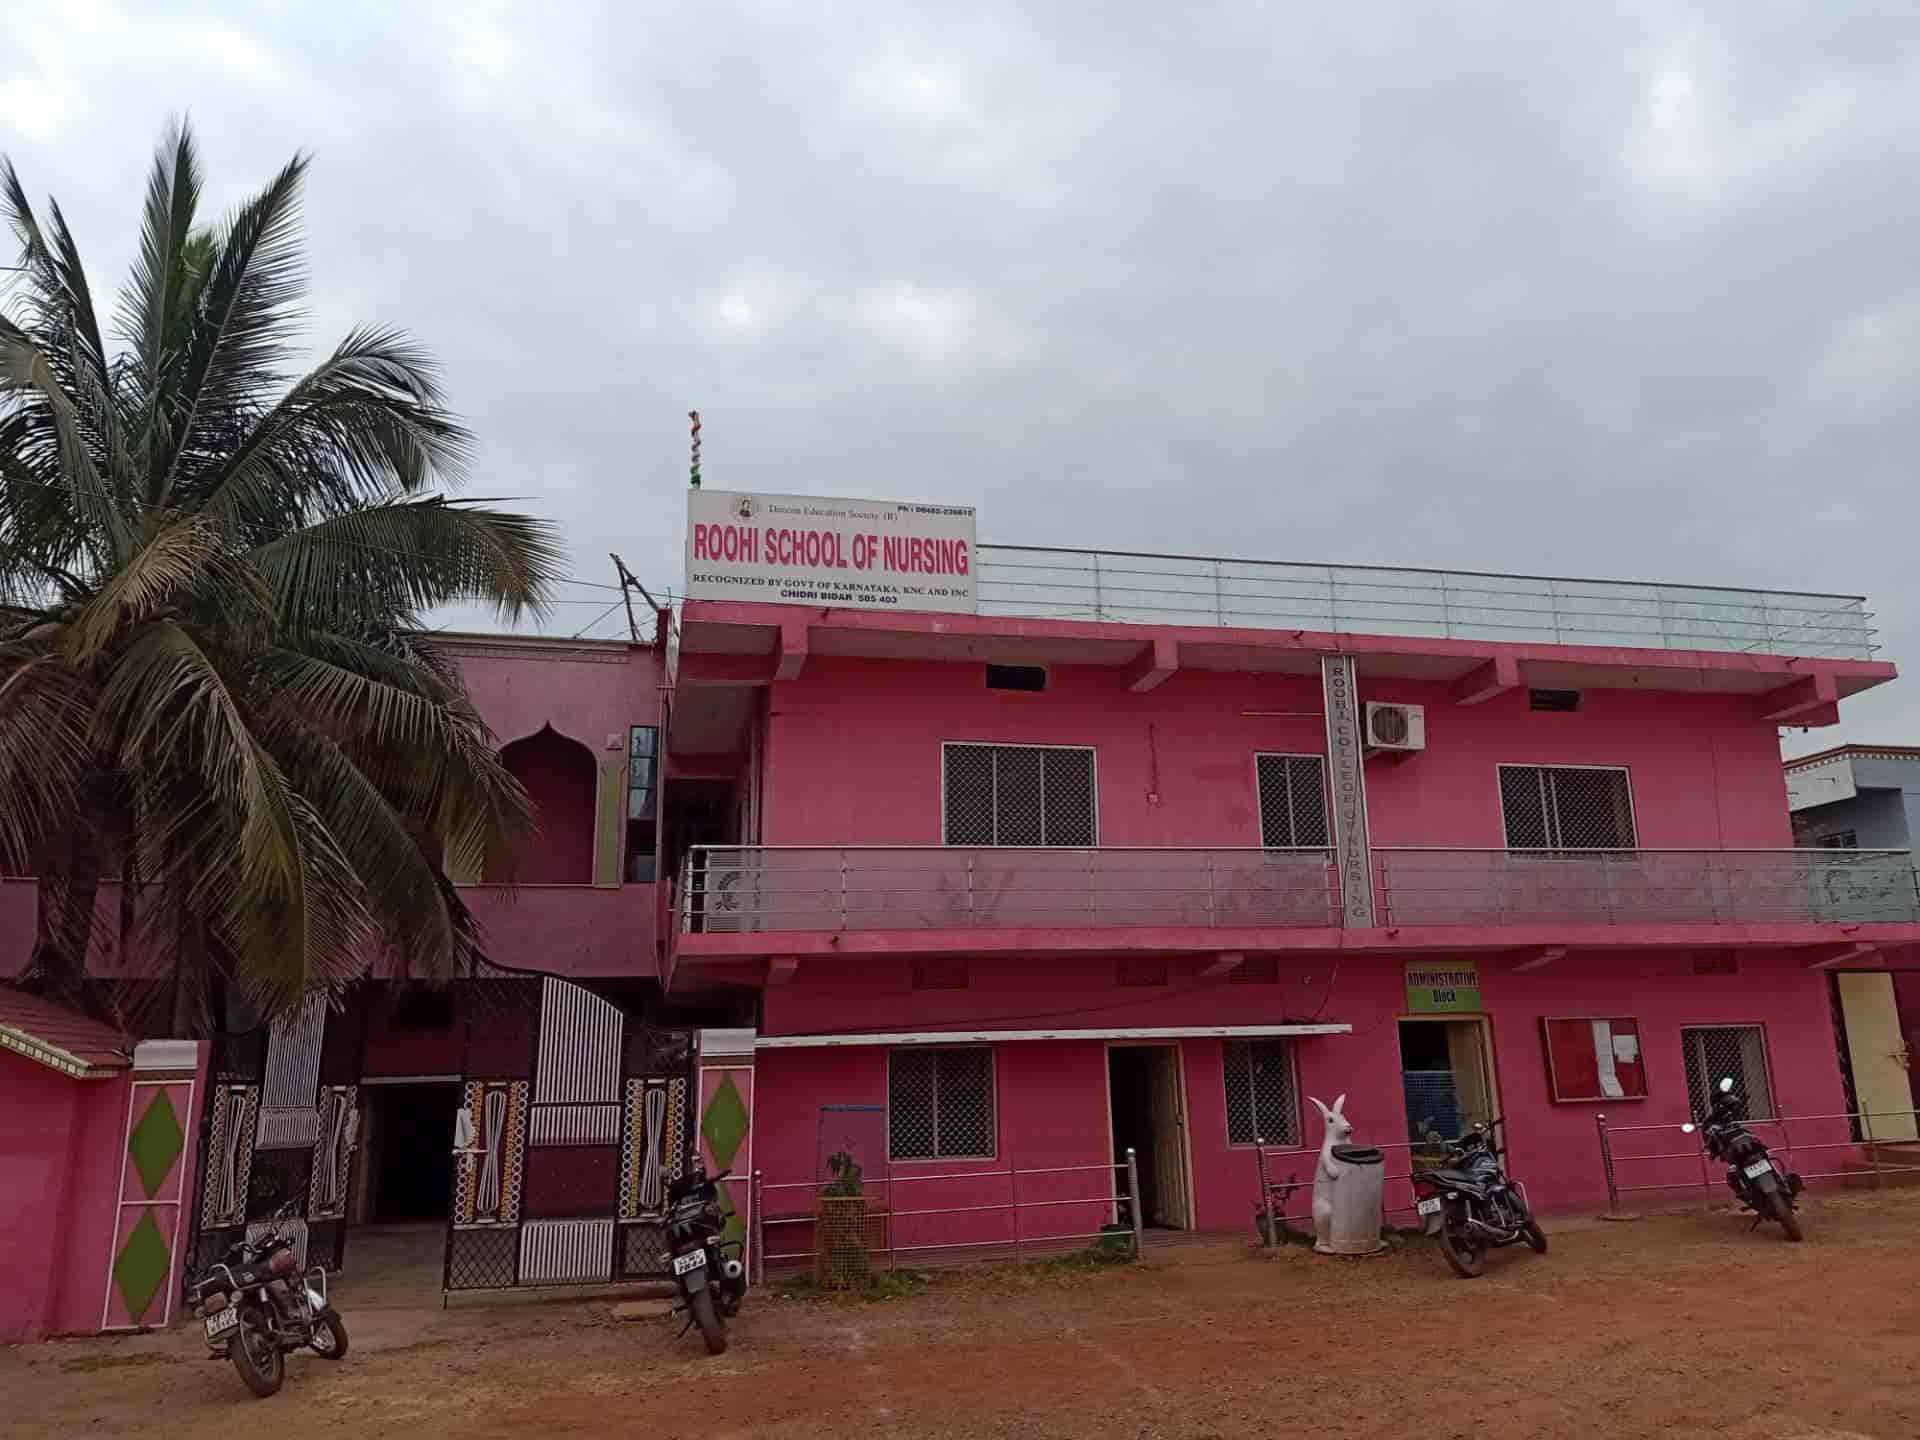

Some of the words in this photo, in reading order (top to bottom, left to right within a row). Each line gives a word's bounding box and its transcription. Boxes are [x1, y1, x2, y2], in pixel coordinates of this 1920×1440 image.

[694, 523, 758, 563] ROOHI
[765, 527, 847, 568] SCHOOL
[852, 533, 877, 571] OF
[883, 535, 969, 577] NURSING
[693, 574, 765, 586] RECOGNIZED
[768, 578, 781, 586] BY
[784, 580, 815, 588] GOVT
[817, 581, 830, 589] OF
[927, 588, 949, 597] AND
[781, 589, 817, 600] CHIDRI
[821, 592, 853, 601] BIDAR
